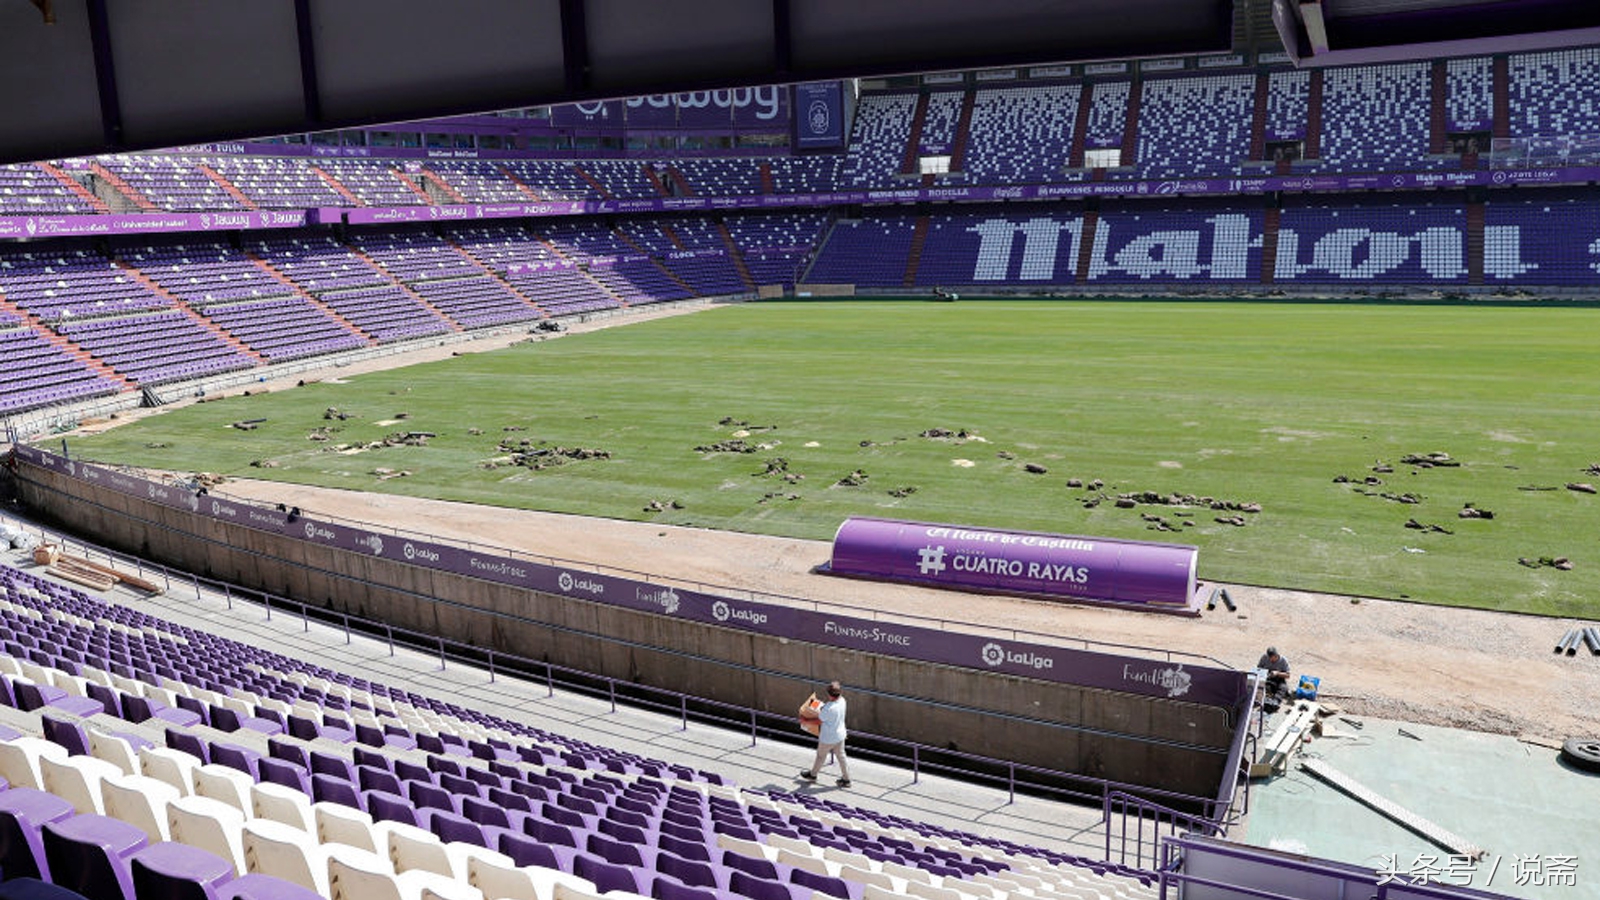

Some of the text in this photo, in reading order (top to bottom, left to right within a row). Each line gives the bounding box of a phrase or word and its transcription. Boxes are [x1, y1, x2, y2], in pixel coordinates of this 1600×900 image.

[928, 188, 969, 197] RODILLA
[926, 527, 1095, 552] El Norte de Castilla
[415, 548, 440, 562] LaLiga
[953, 556, 1089, 584] CUATRO RAYAS
[574, 577, 604, 594] LaLiga
[732, 608, 768, 624] LaLiga
[1007, 651, 1054, 670] LaLiga
